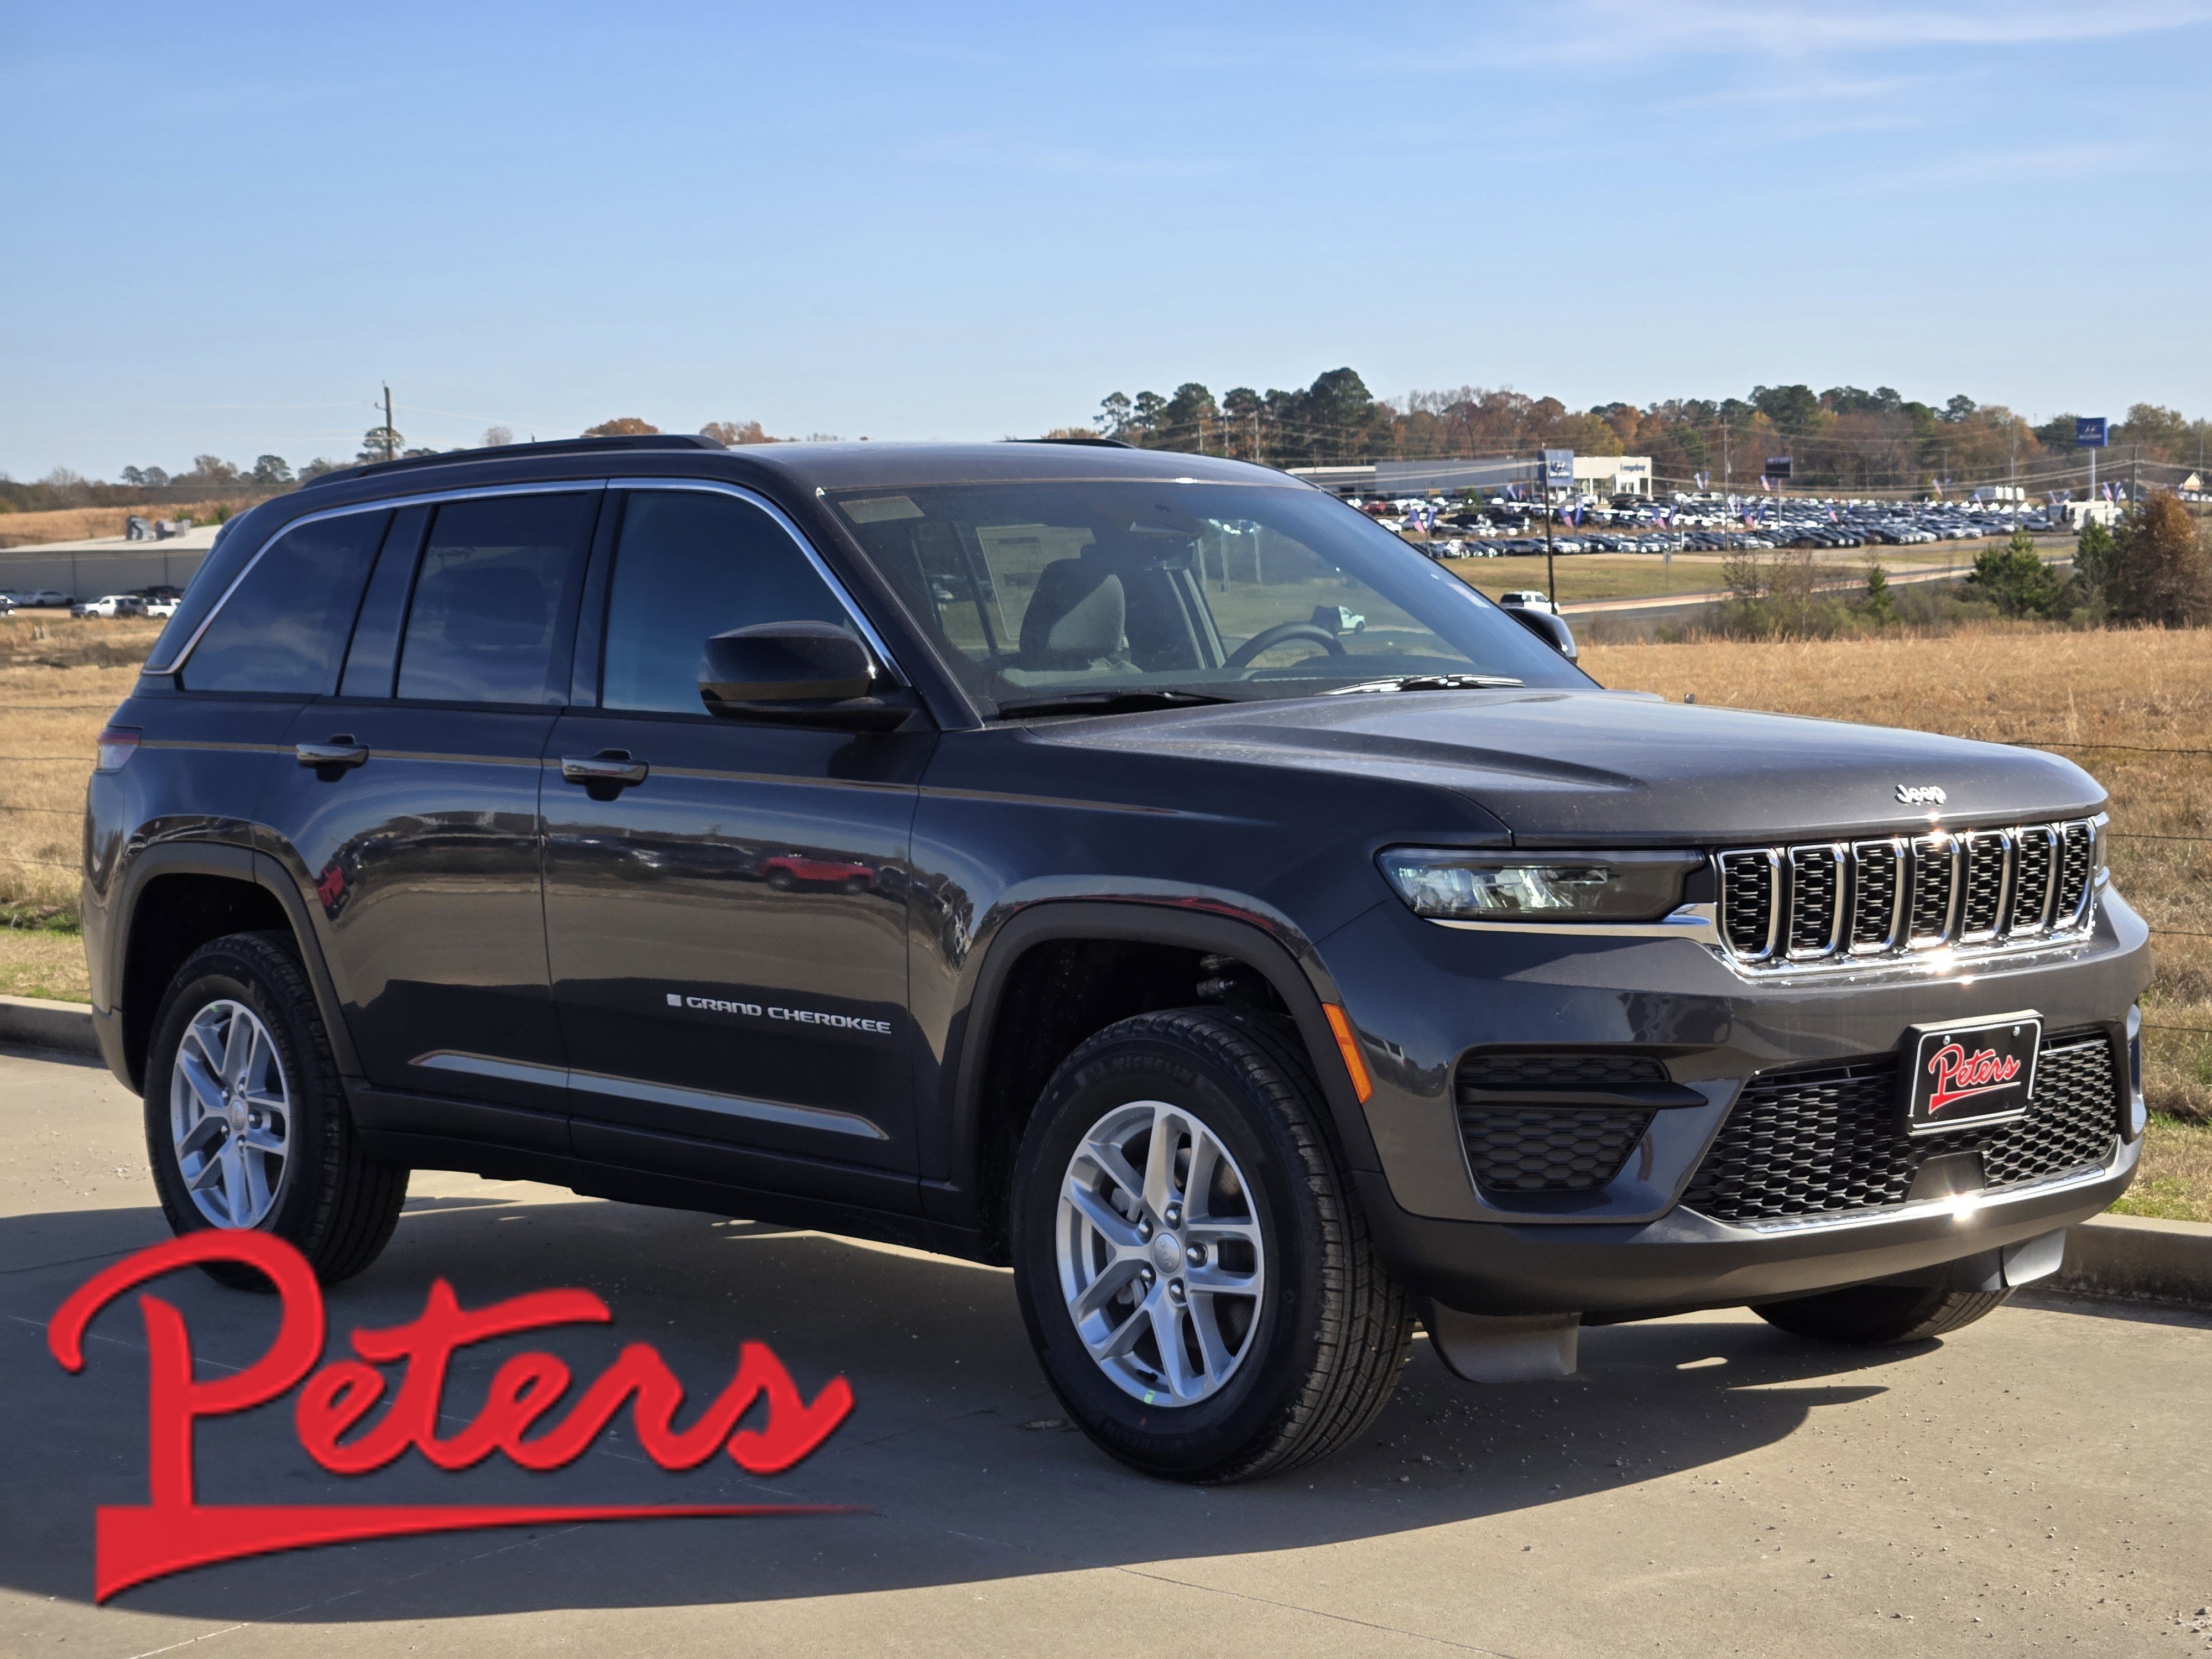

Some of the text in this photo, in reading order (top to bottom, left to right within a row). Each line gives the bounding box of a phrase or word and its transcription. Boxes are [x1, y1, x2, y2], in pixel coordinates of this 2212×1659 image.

[1896, 784, 1947, 804] Jeep
[686, 996, 892, 1035] GRAND CHEROKEE
[1928, 1043, 2021, 1098] Peters
